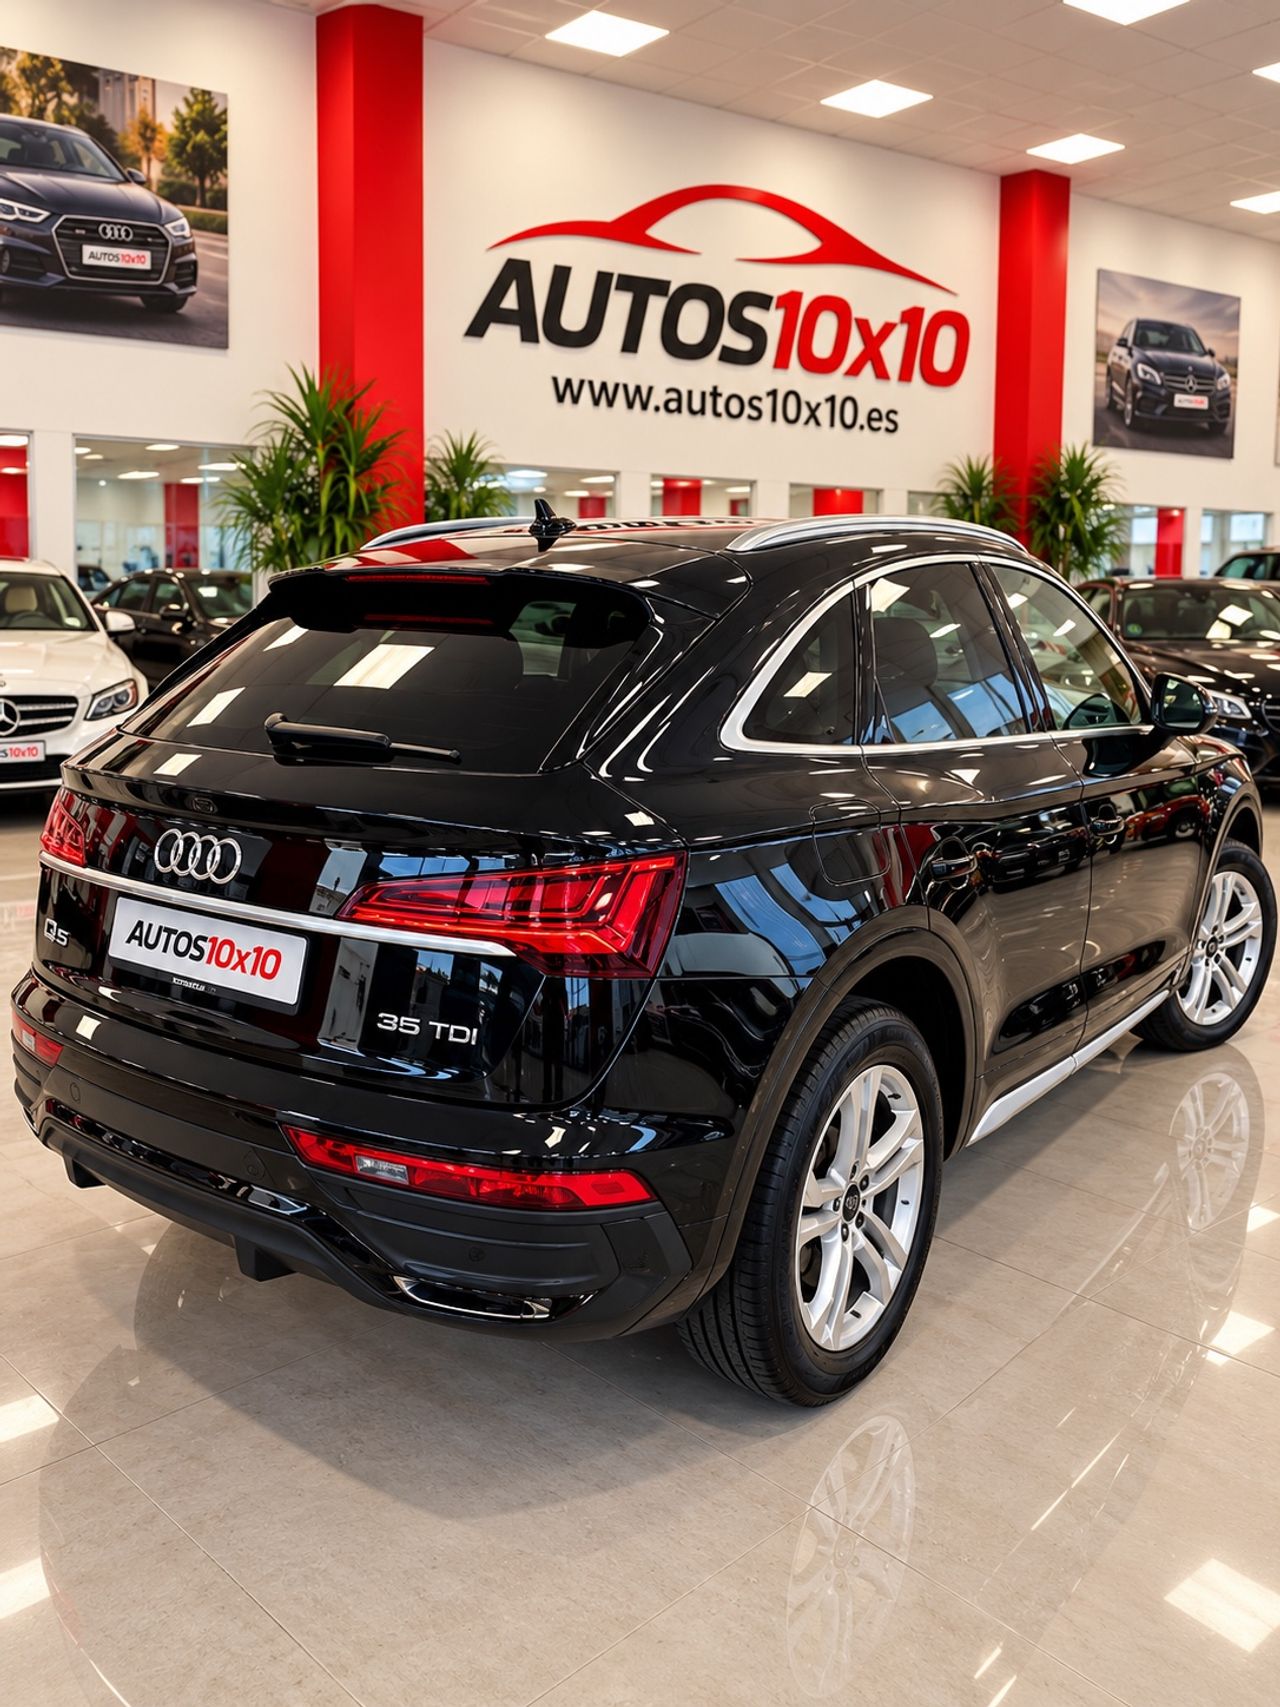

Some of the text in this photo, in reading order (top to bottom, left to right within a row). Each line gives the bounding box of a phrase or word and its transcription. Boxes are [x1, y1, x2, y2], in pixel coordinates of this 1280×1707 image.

[463, 257, 970, 388] AUTOS10x10
[552, 376, 899, 433] www.autos10x10.es
[44, 918, 70, 946] Q5
[125, 919, 282, 981] AUTOS10x10
[377, 1012, 478, 1045] 35 TDI
